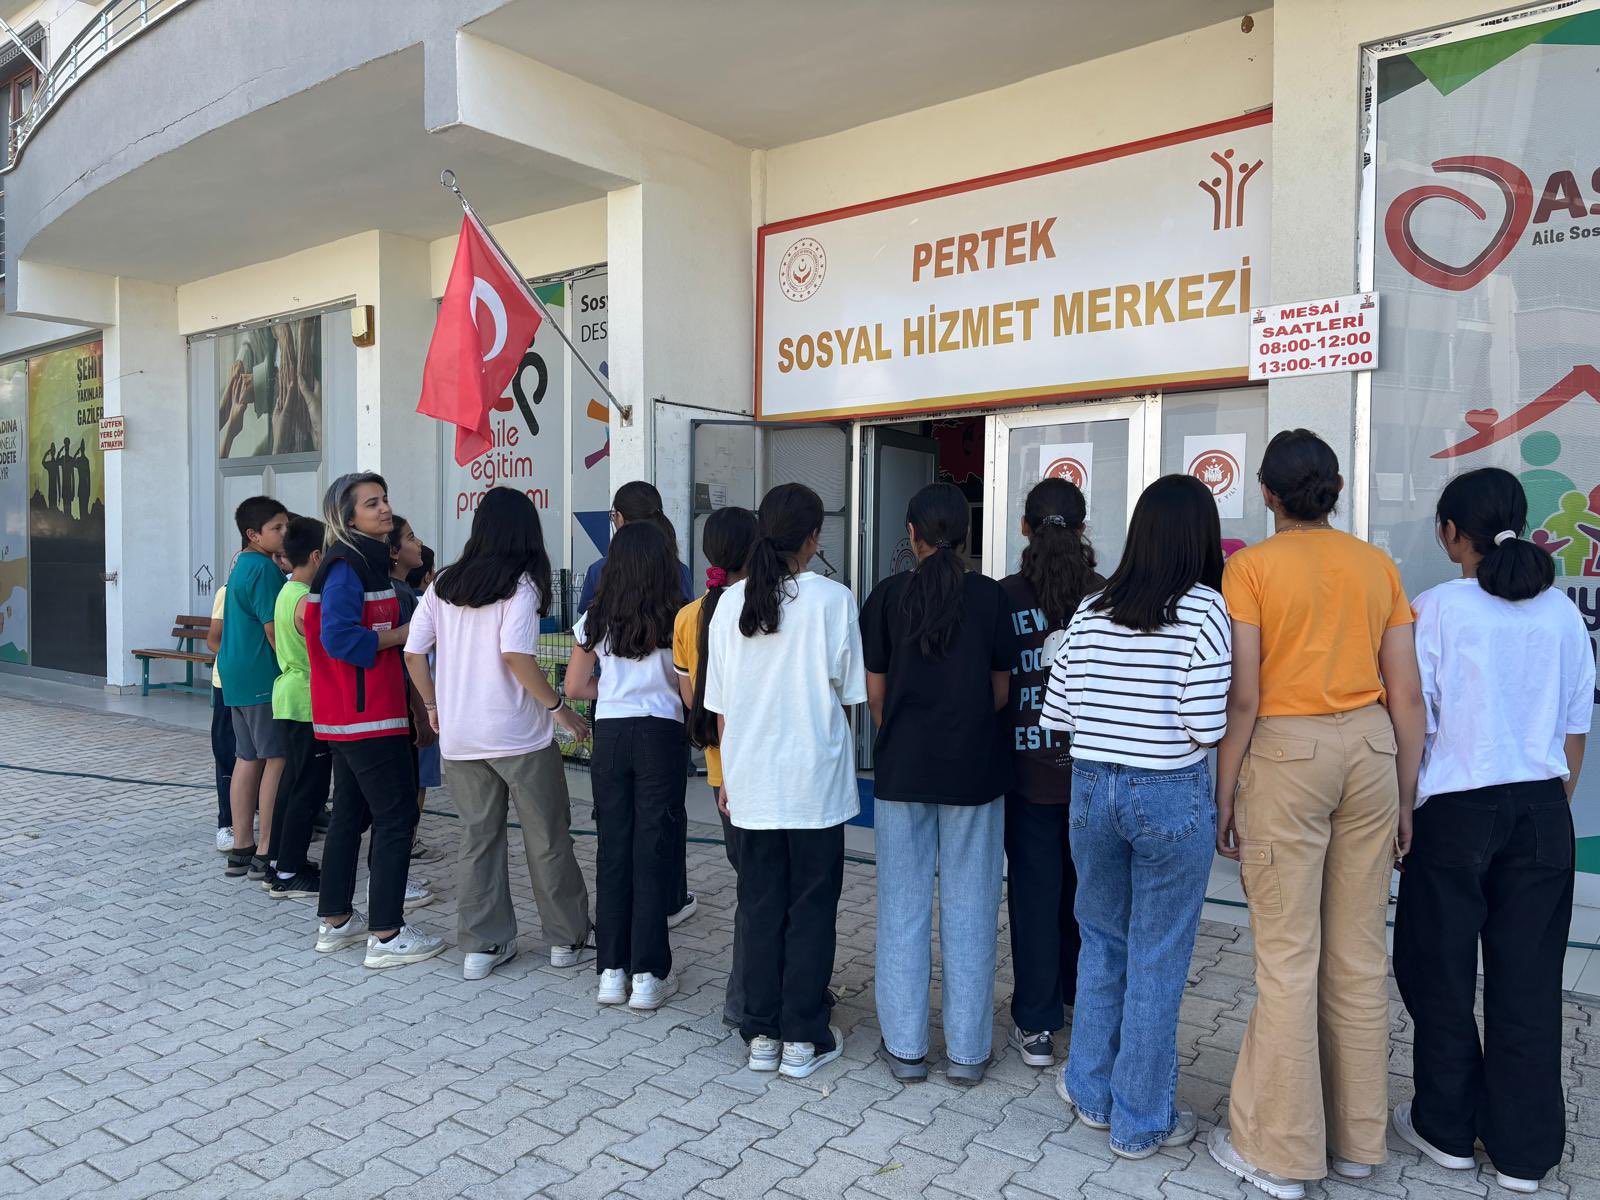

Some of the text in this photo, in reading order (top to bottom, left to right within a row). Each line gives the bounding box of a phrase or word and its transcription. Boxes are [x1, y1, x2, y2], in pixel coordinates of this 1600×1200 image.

[1532, 166, 1600, 224] A
[912, 217, 1057, 282] PERTEK
[1532, 230, 1565, 246] Aile
[778, 256, 1251, 374] SOSYAL HİZMET MERKEZİ
[1280, 300, 1340, 321] MESAİ
[1262, 313, 1364, 338] SAATLERİ
[1259, 331, 1371, 355] 08:00-12:00
[1258, 351, 1373, 374] 13:00-17:00
[100, 419, 123, 429] LÜTFEN
[100, 430, 113, 439] YERE
[100, 440, 123, 449] ATMAYIN
[471, 450, 533, 488] eğitim
[1015, 726, 1061, 751] EST.
